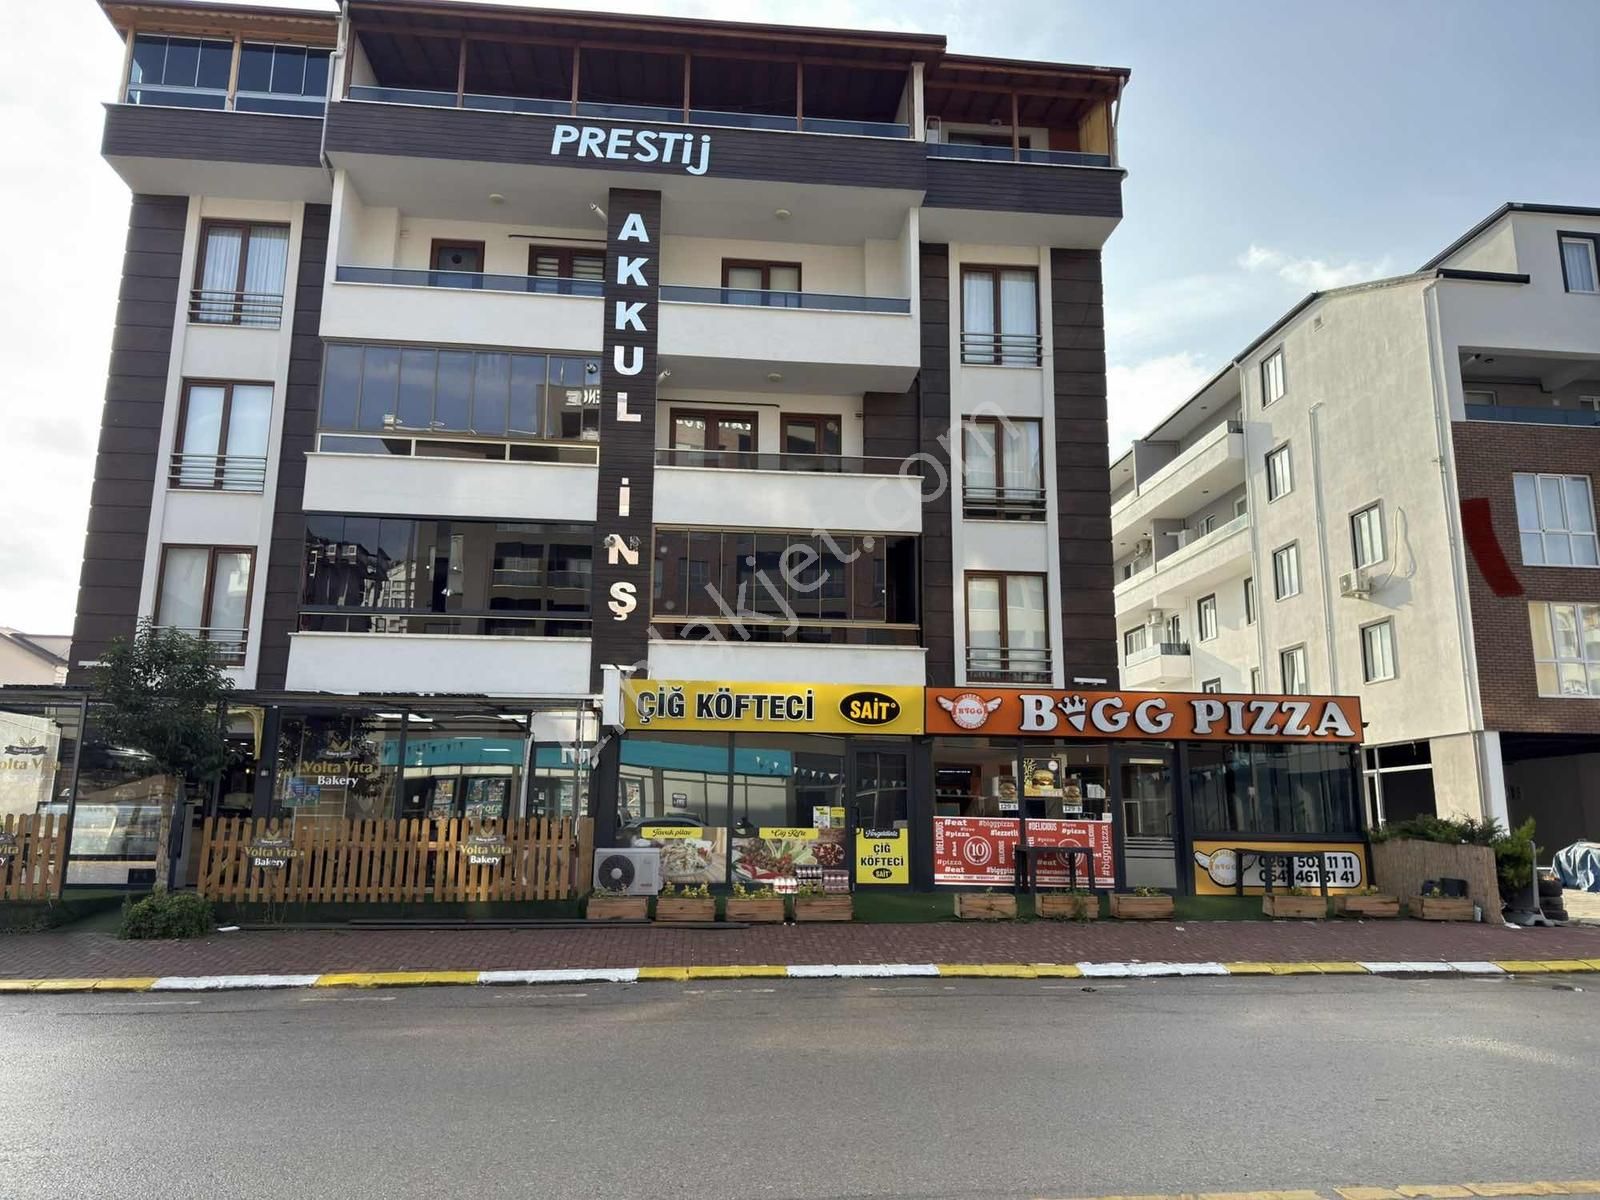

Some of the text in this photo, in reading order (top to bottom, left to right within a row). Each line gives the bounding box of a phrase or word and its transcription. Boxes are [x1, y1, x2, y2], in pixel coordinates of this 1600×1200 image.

[613, 213, 650, 422] AKKUL
[636, 686, 816, 724] ÇİĞ KÖFTECİ
[1191, 700, 1356, 737] PIZZA
[0, 758, 27, 770] olta
[303, 761, 373, 773] Volta Vita
[317, 775, 358, 788] Bakery
[244, 847, 297, 857] Volta Vita
[460, 845, 512, 855] Volta Vita
[254, 857, 285, 868] Bakery
[470, 855, 500, 865] Bakery
[861, 855, 904, 866] KÖFTECİ
[1326, 856, 1338, 869] 11
[1341, 856, 1353, 869] 11
[1296, 870, 1319, 883] 461
[1341, 870, 1355, 883] 41
